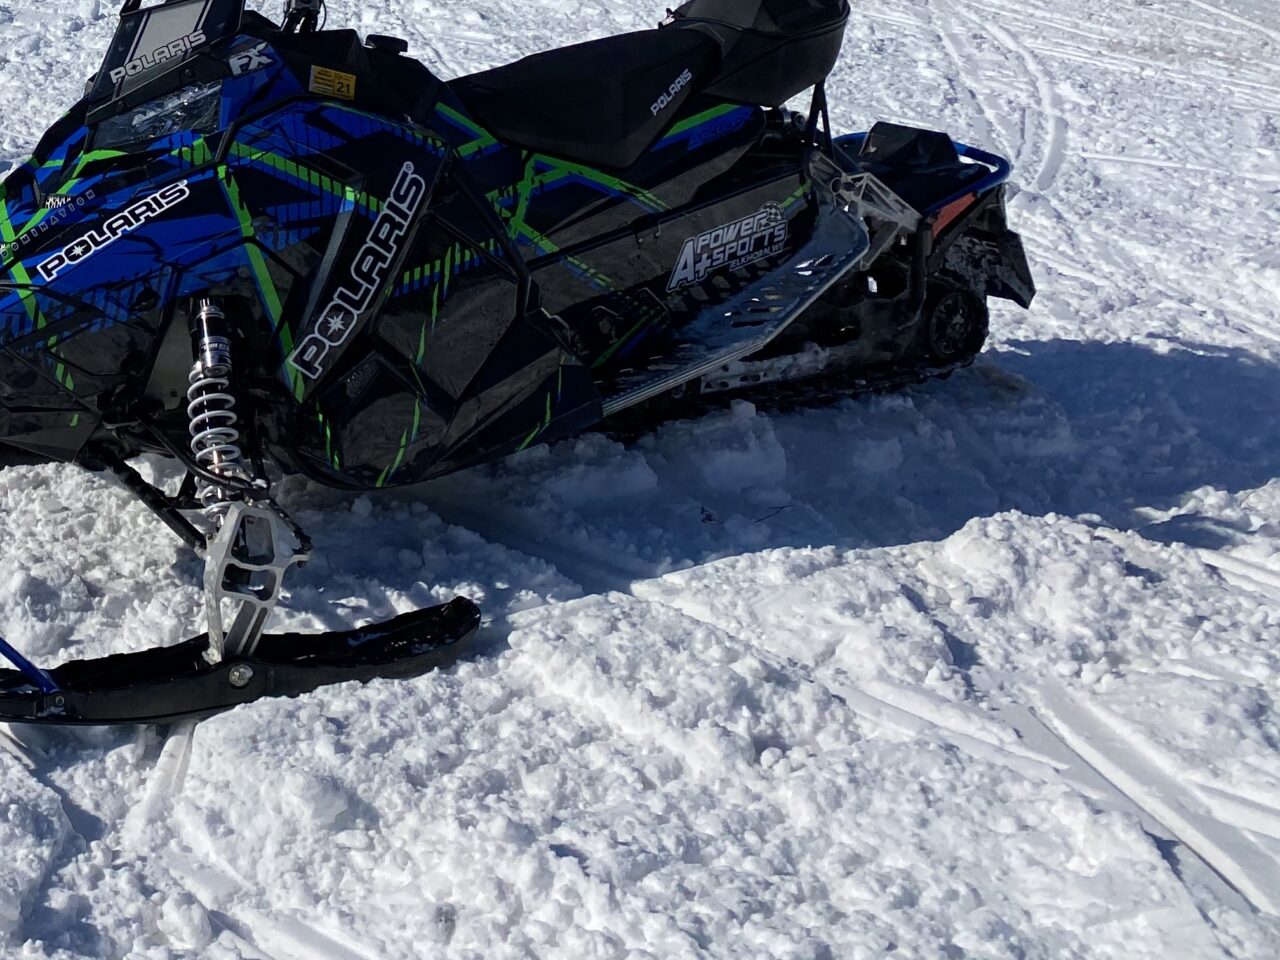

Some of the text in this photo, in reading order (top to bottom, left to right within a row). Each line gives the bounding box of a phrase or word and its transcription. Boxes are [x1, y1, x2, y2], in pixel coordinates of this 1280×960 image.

[109, 29, 207, 84] POLARIS
[336, 80, 351, 97] 21
[649, 68, 692, 116] POLARIS
[0, 189, 96, 259] DOMINATION
[36, 181, 190, 282] POLARIS
[289, 164, 425, 379] POLARIS
